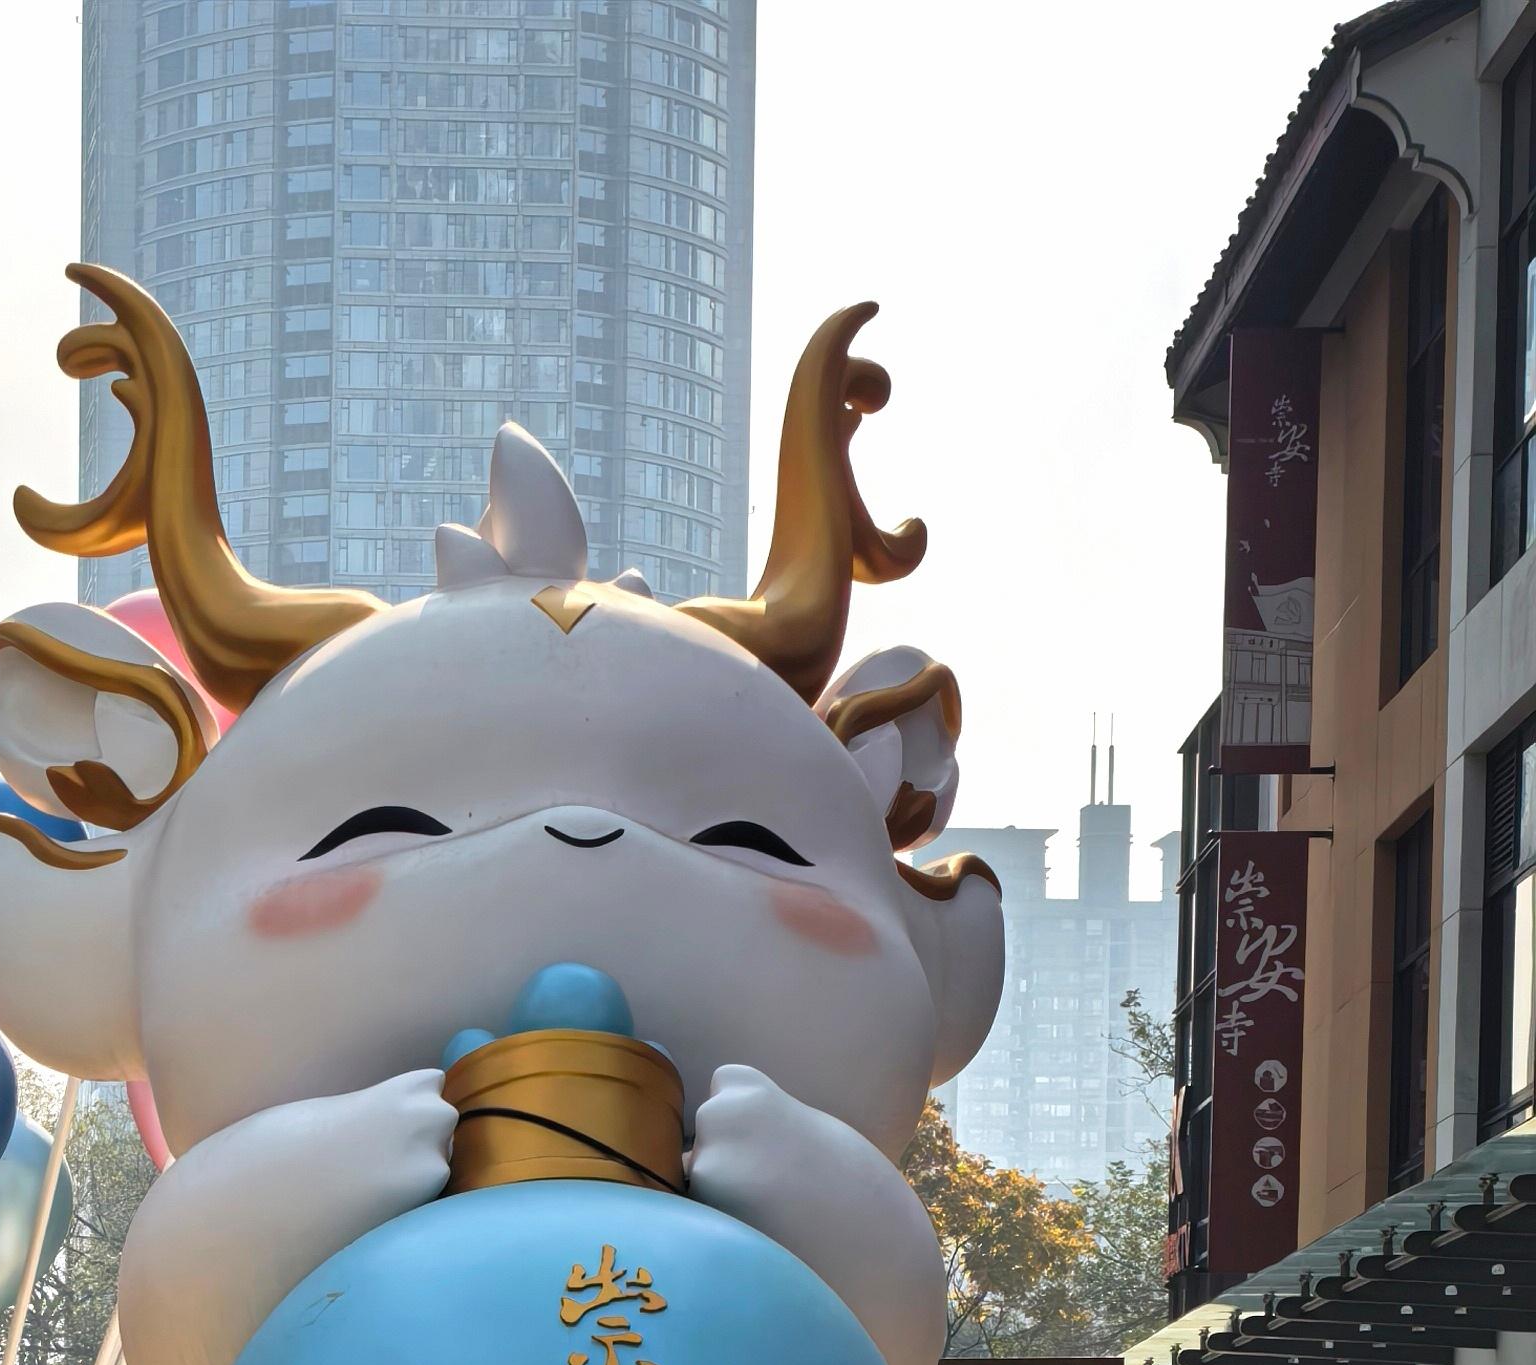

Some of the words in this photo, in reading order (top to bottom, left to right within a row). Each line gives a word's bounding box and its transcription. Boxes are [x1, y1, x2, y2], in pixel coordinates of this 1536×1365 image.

[1265, 395, 1310, 487] 崇安寺
[1216, 860, 1305, 1056] 崇安寺
